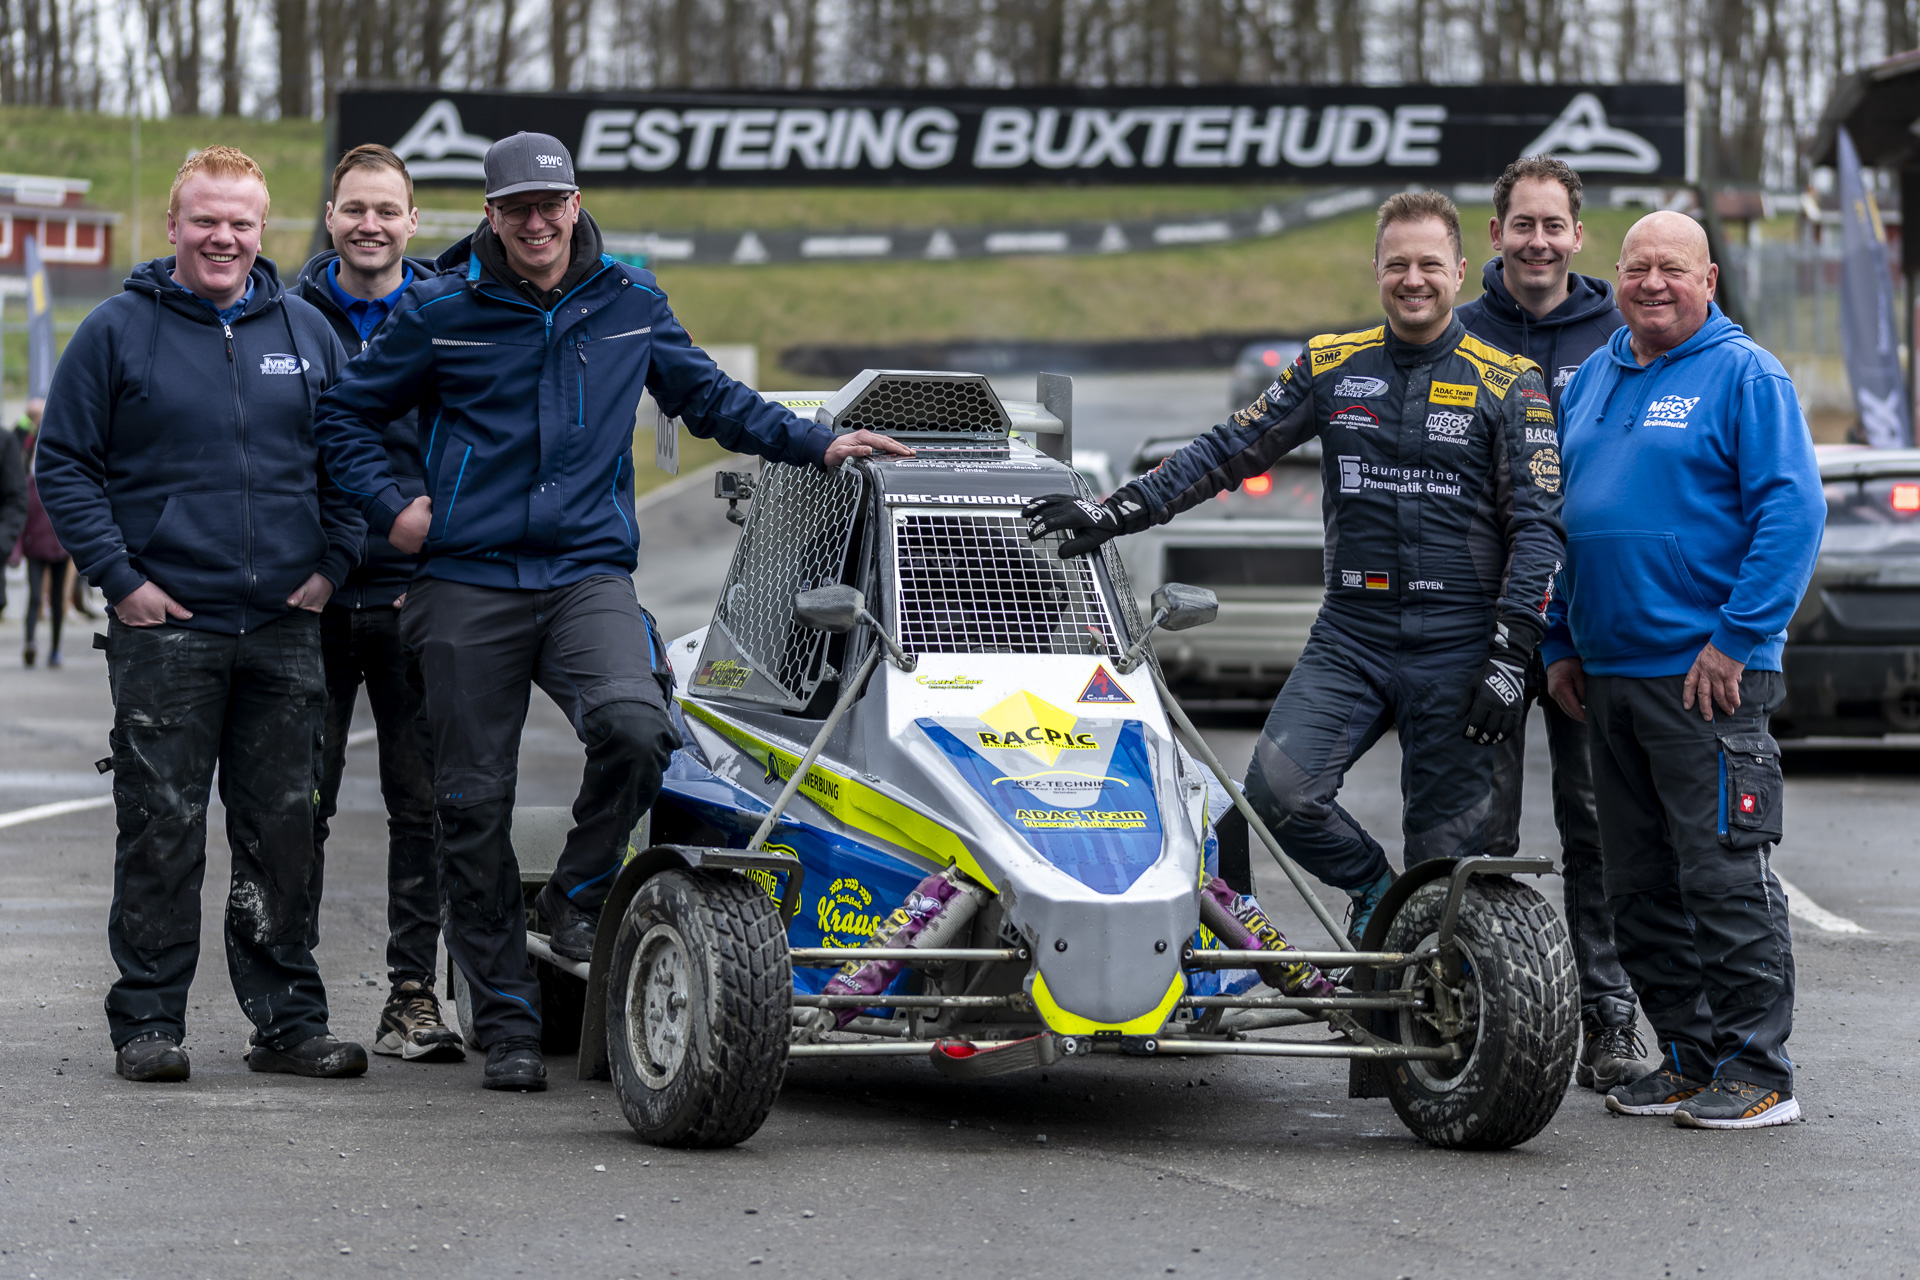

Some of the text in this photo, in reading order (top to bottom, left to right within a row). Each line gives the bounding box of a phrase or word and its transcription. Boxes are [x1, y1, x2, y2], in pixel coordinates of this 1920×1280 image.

[576, 104, 1446, 170] ESTERING BUXTEHUDE
[536, 154, 563, 167] BWC
[1314, 350, 1342, 364] OMP
[1484, 370, 1511, 387] OMP
[1333, 390, 1363, 398] FRAMES
[1433, 386, 1474, 397] ADAC Team
[1647, 400, 1684, 413] MSC
[1336, 413, 1373, 423] KFZ-TECHNIK
[1428, 416, 1460, 429] MSC
[1643, 419, 1689, 429] Gründautal
[1428, 433, 1469, 446] Gründautal
[1361, 462, 1461, 482] Baumgartner
[1528, 460, 1561, 476] Krau
[1363, 477, 1461, 496] Pneumatik GmbH
[884, 493, 1034, 505] msc-gruenda
[1341, 573, 1363, 586] OMP
[1408, 580, 1444, 591] STEVEN
[978, 726, 1097, 746] RACPIC
[1015, 780, 1107, 788] KFZ-TECHNIK
[1017, 809, 1145, 820] ADAC Team
[817, 895, 881, 938] Kraus
